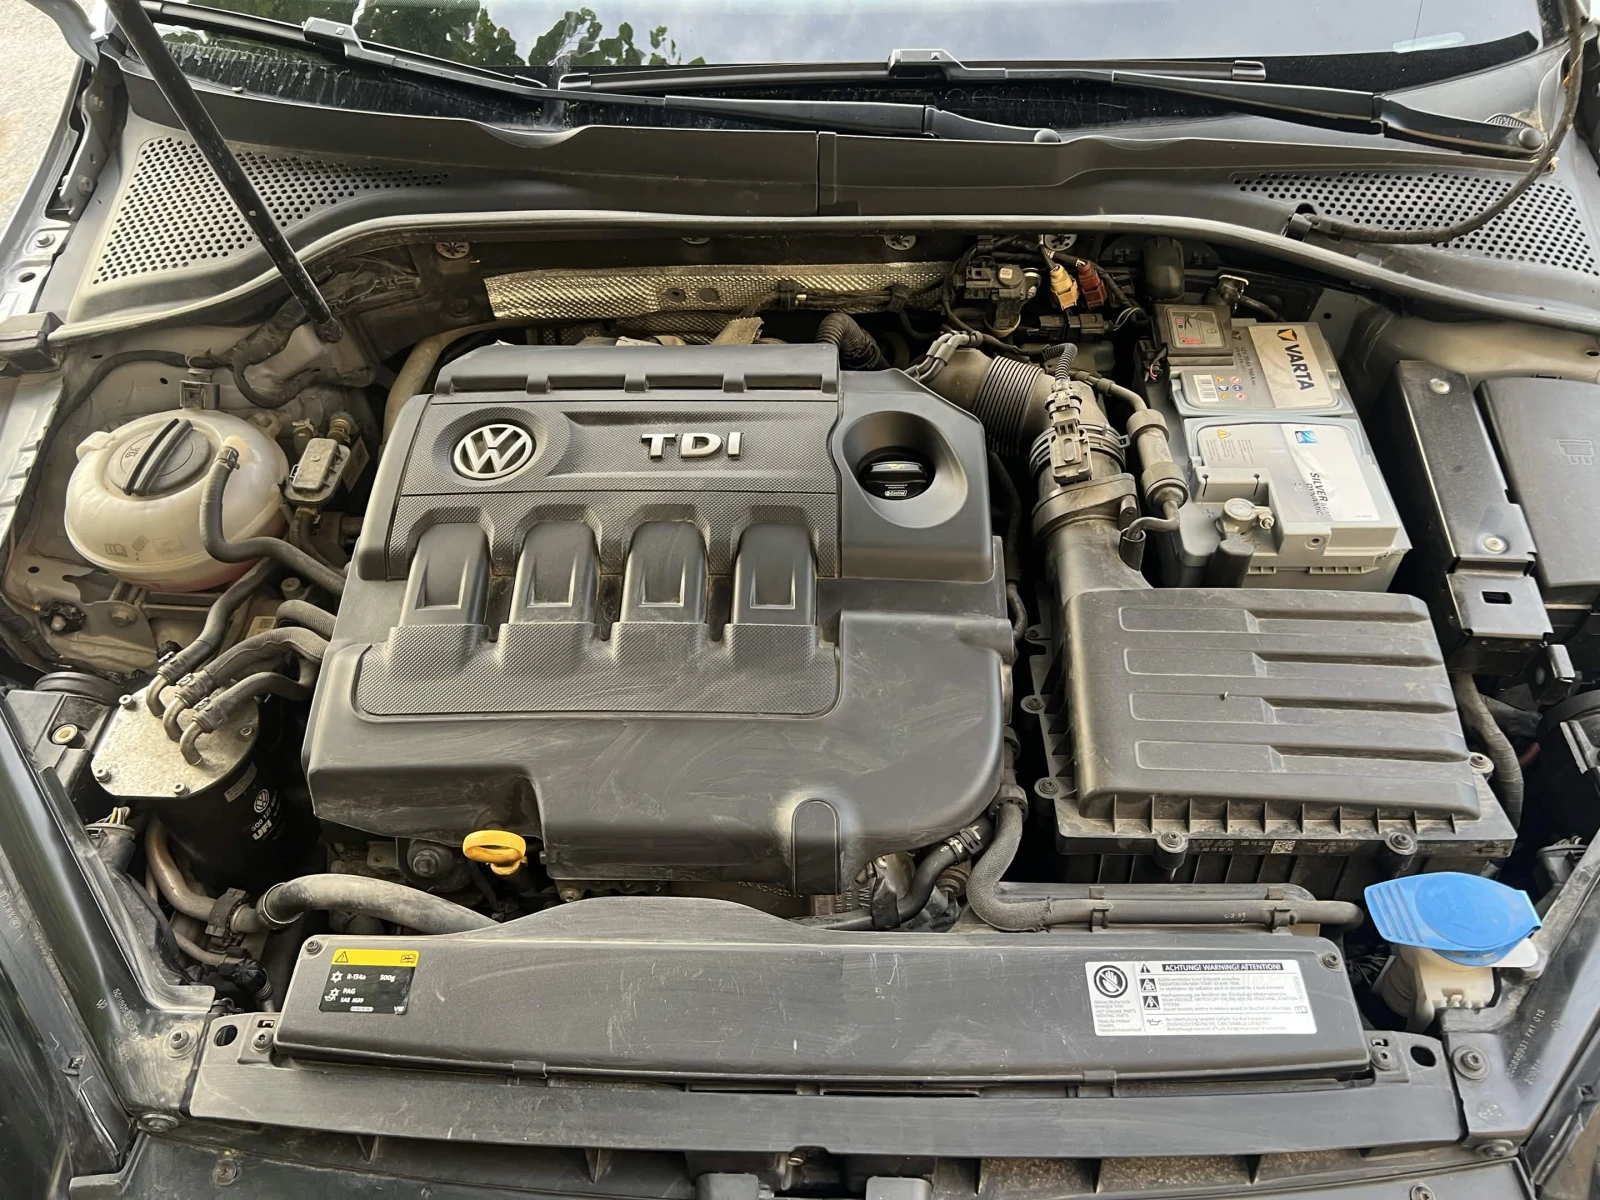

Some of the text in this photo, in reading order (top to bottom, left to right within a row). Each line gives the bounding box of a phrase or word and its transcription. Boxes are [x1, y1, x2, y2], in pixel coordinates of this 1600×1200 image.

[1284, 344, 1315, 391] VARTA
[641, 431, 743, 459] TDI
[1306, 483, 1322, 516] DYNAMIC
[1310, 472, 1328, 503] SILVER
[252, 819, 272, 840] UFI
[380, 974, 396, 982] 500g
